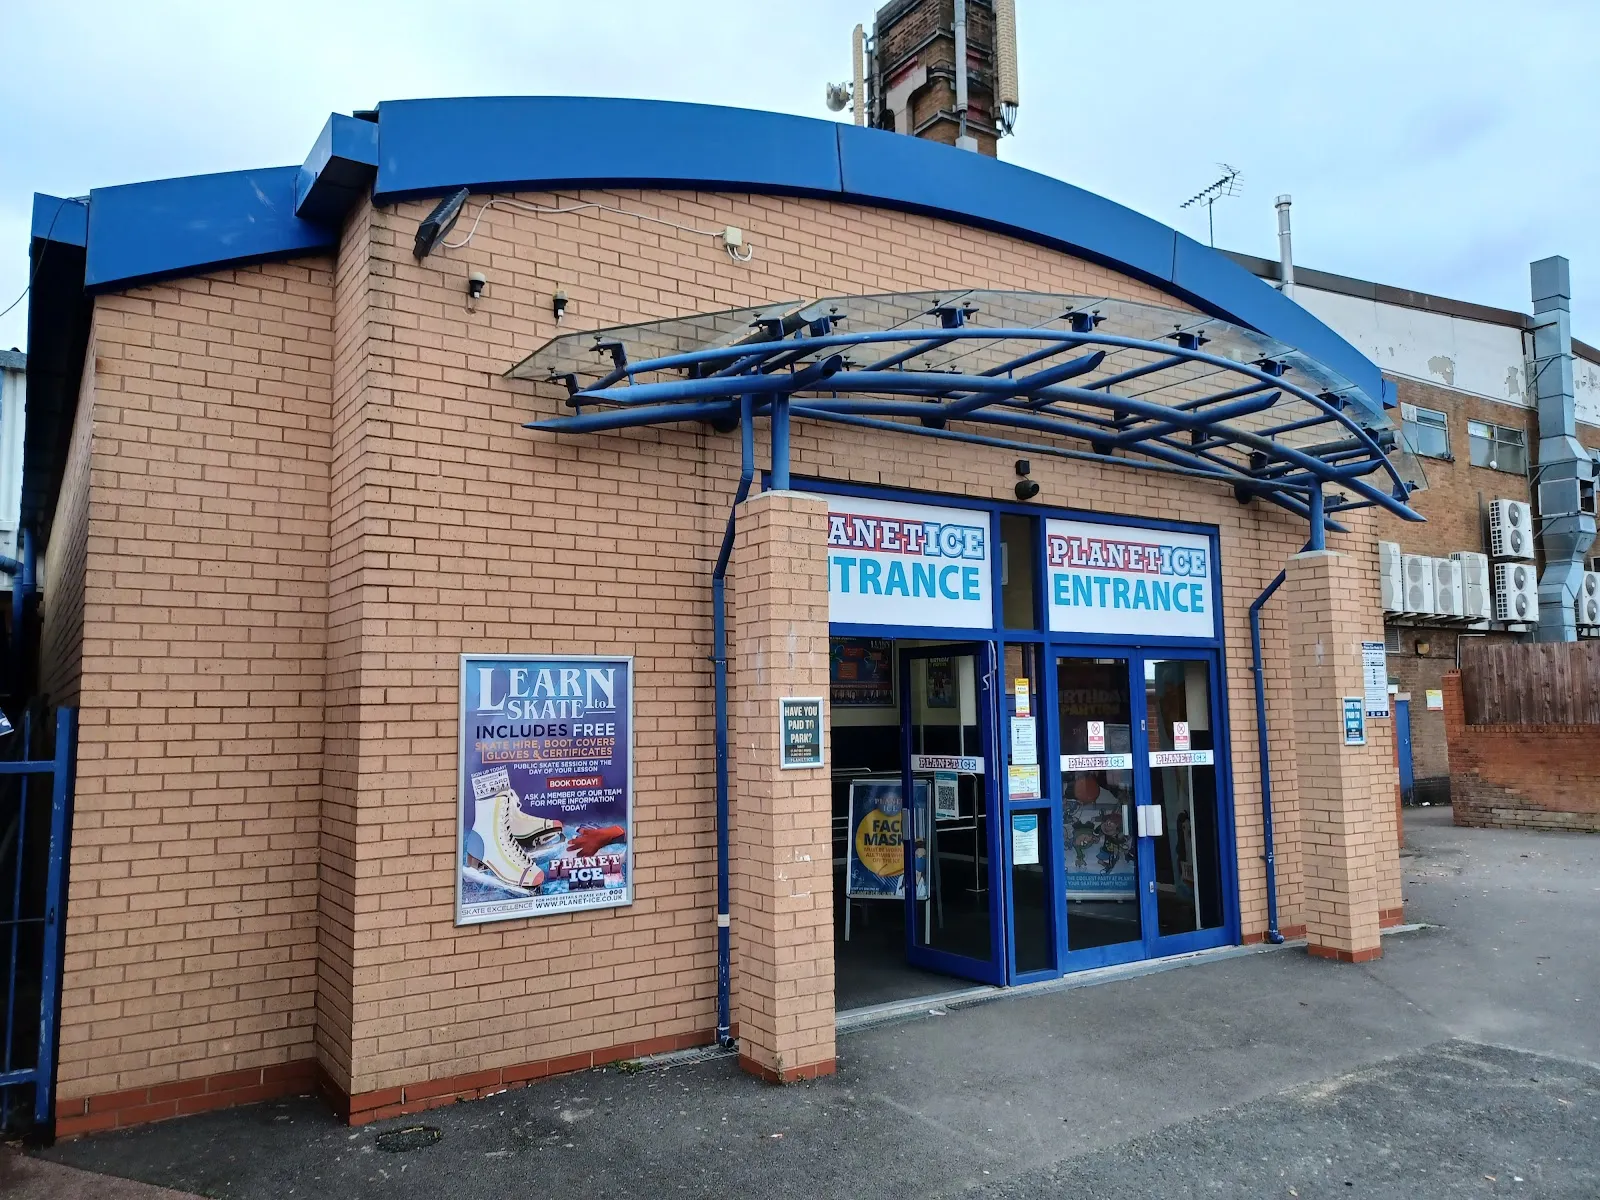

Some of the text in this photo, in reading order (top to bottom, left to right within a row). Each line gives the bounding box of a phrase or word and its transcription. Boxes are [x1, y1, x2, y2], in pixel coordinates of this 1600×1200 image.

[828, 512, 984, 560] ANETICE
[828, 556, 980, 600] TRANCE
[1054, 573, 1204, 613] ENTRANCE
[477, 667, 616, 711] LEARN
[507, 699, 585, 720] SKATE
[595, 699, 605, 709] to
[785, 706, 818, 717] HAVE YOU
[476, 723, 615, 739] INCLUDES FREE
[788, 720, 814, 730] PAID TO
[475, 737, 616, 750] SKATE HIRE, BOOT COVERS
[791, 733, 813, 744] PARK?
[487, 747, 613, 760] GLOVES & CERTIFICATES
[539, 761, 560, 769] SKATE
[561, 760, 588, 768] SESSION
[550, 778, 598, 788] BOOK TODAY!
[524, 793, 539, 801] ASK
[548, 791, 576, 799] MEMBER
[546, 798, 567, 806] MORE
[568, 796, 615, 805] INFORMATION
[561, 804, 587, 812] TODAY!
[873, 820, 902, 832] FAC
[550, 854, 620, 870] PLANET
[569, 868, 604, 882] ICE
[536, 895, 622, 909] WWW.PLANET-ICE.CO.UK
[462, 902, 533, 916] SKATE EXCELLENCE
